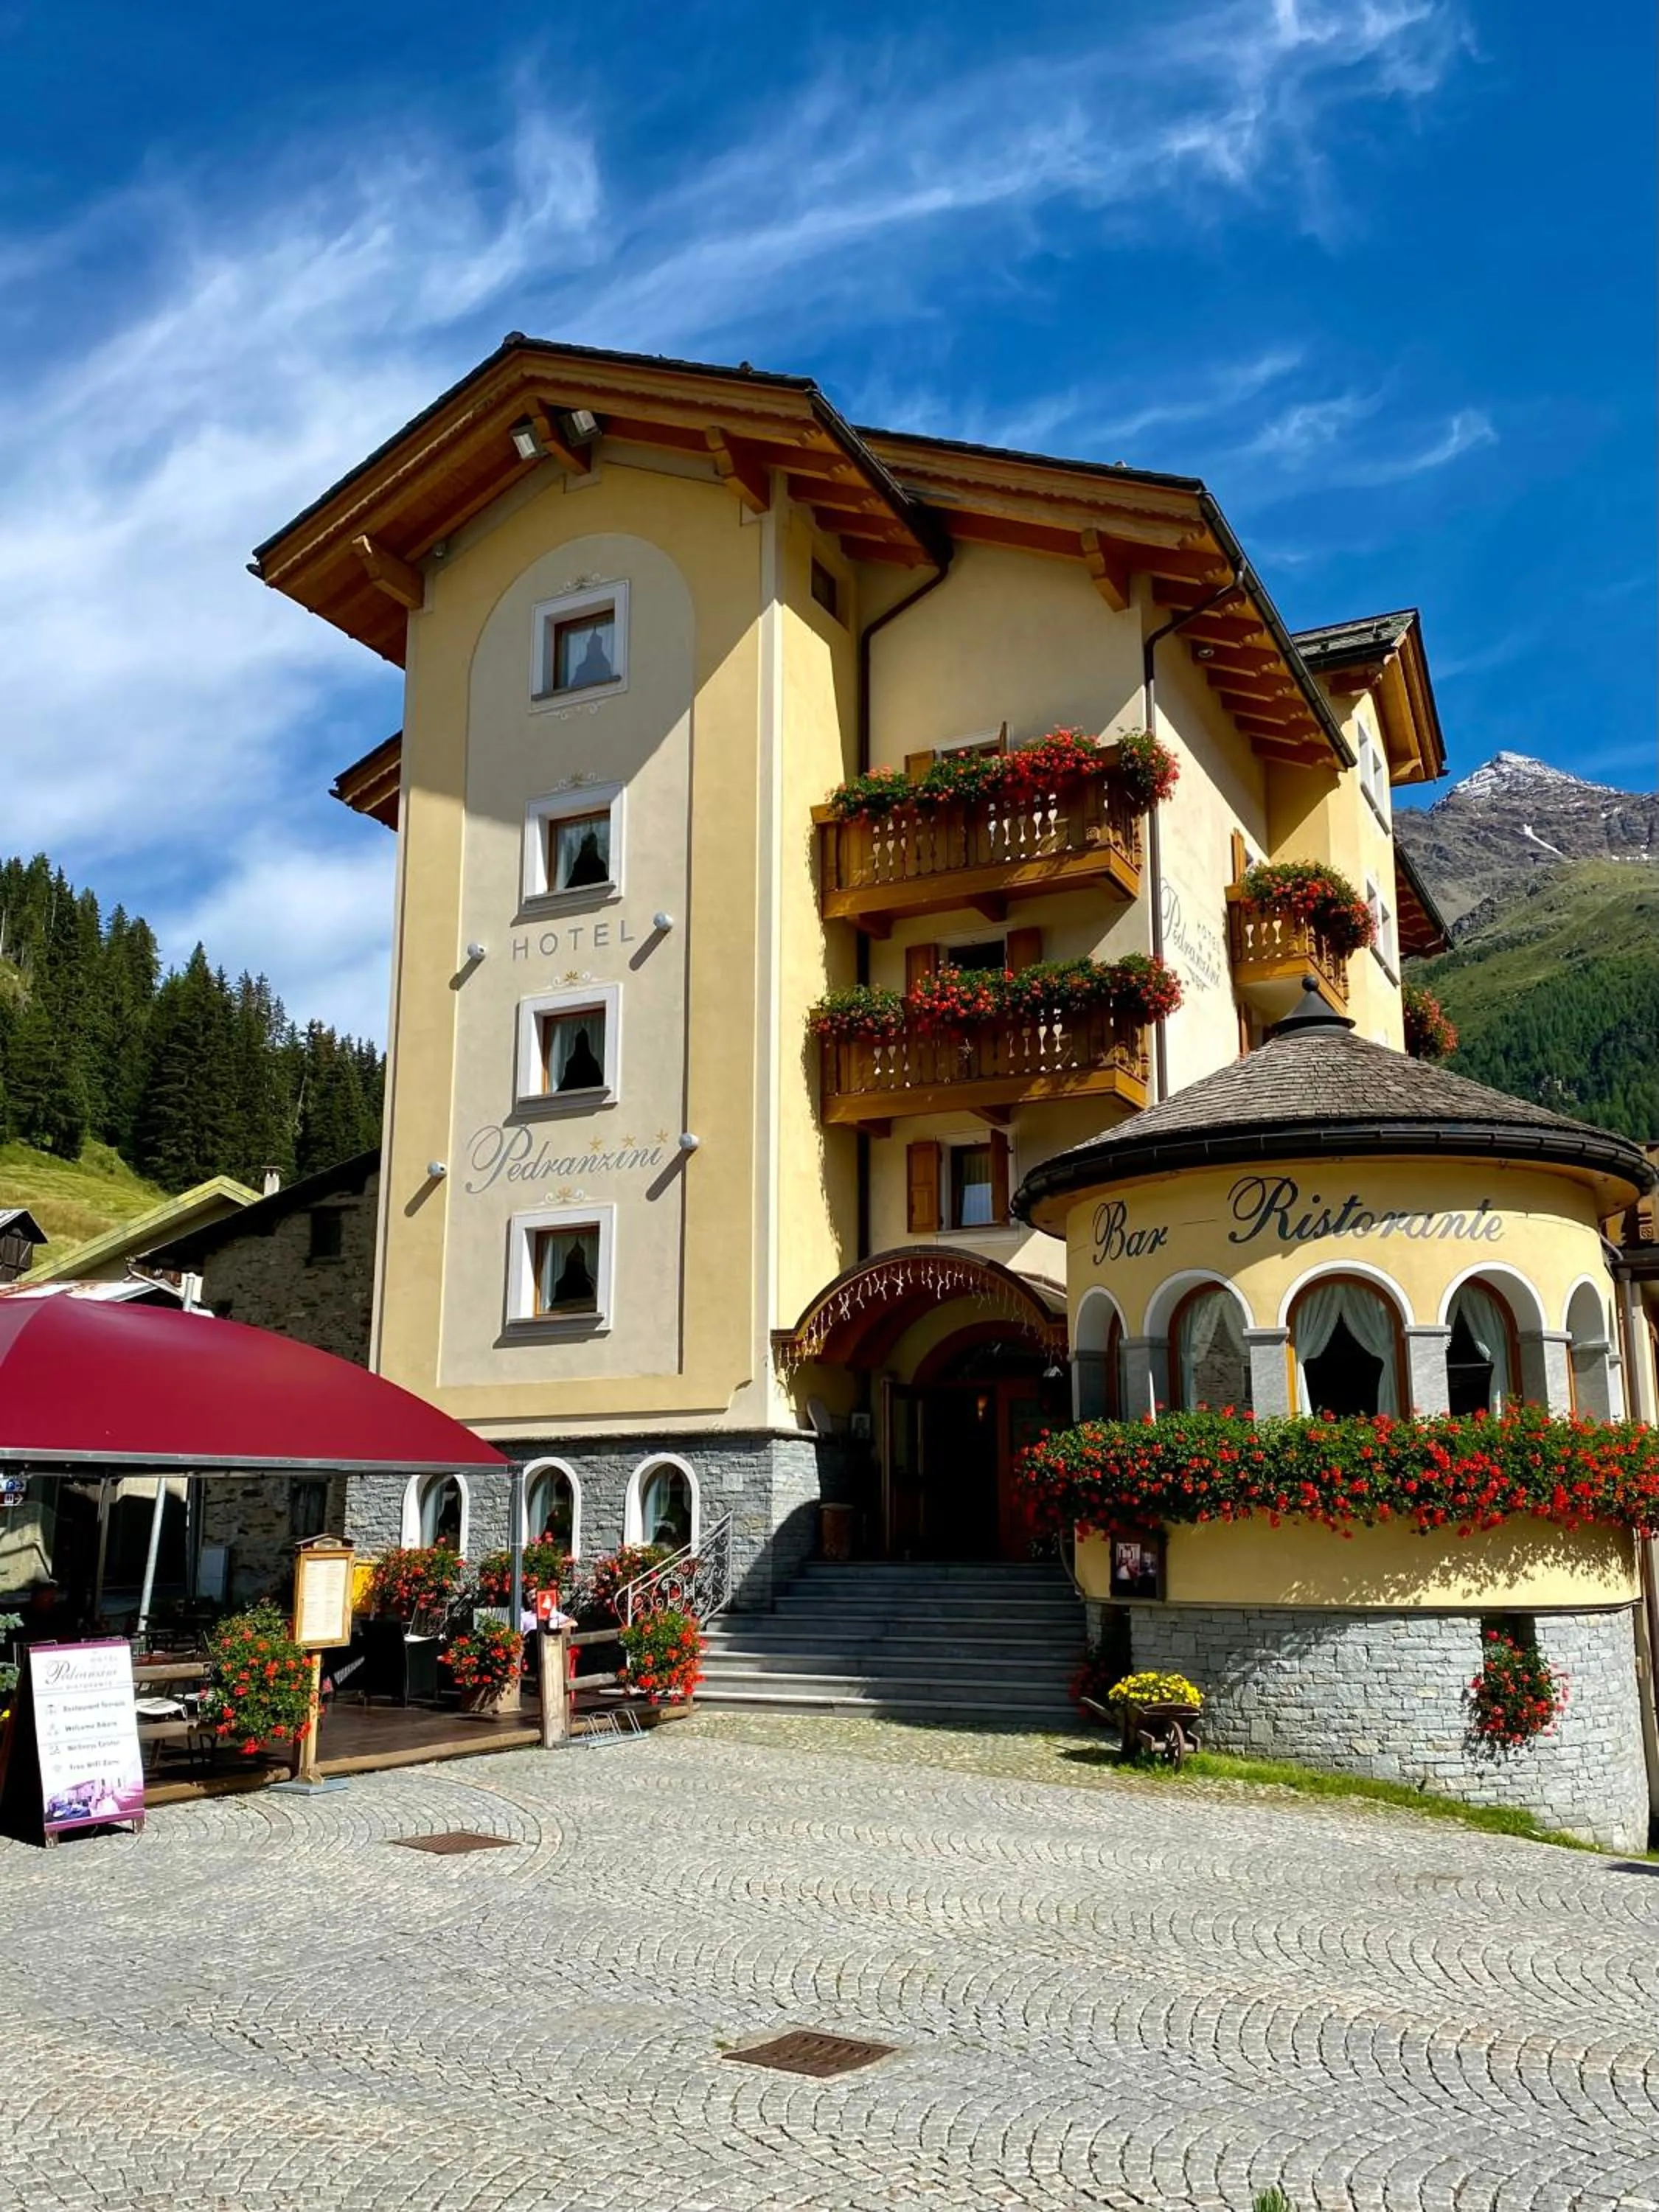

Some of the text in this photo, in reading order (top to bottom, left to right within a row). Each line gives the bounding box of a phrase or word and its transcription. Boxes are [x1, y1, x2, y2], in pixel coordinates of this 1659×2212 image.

[514, 919, 635, 960] HOTEL
[465, 1124, 662, 1194] Pedranzini
[1092, 1175, 1507, 1266] Bar Ristorante
